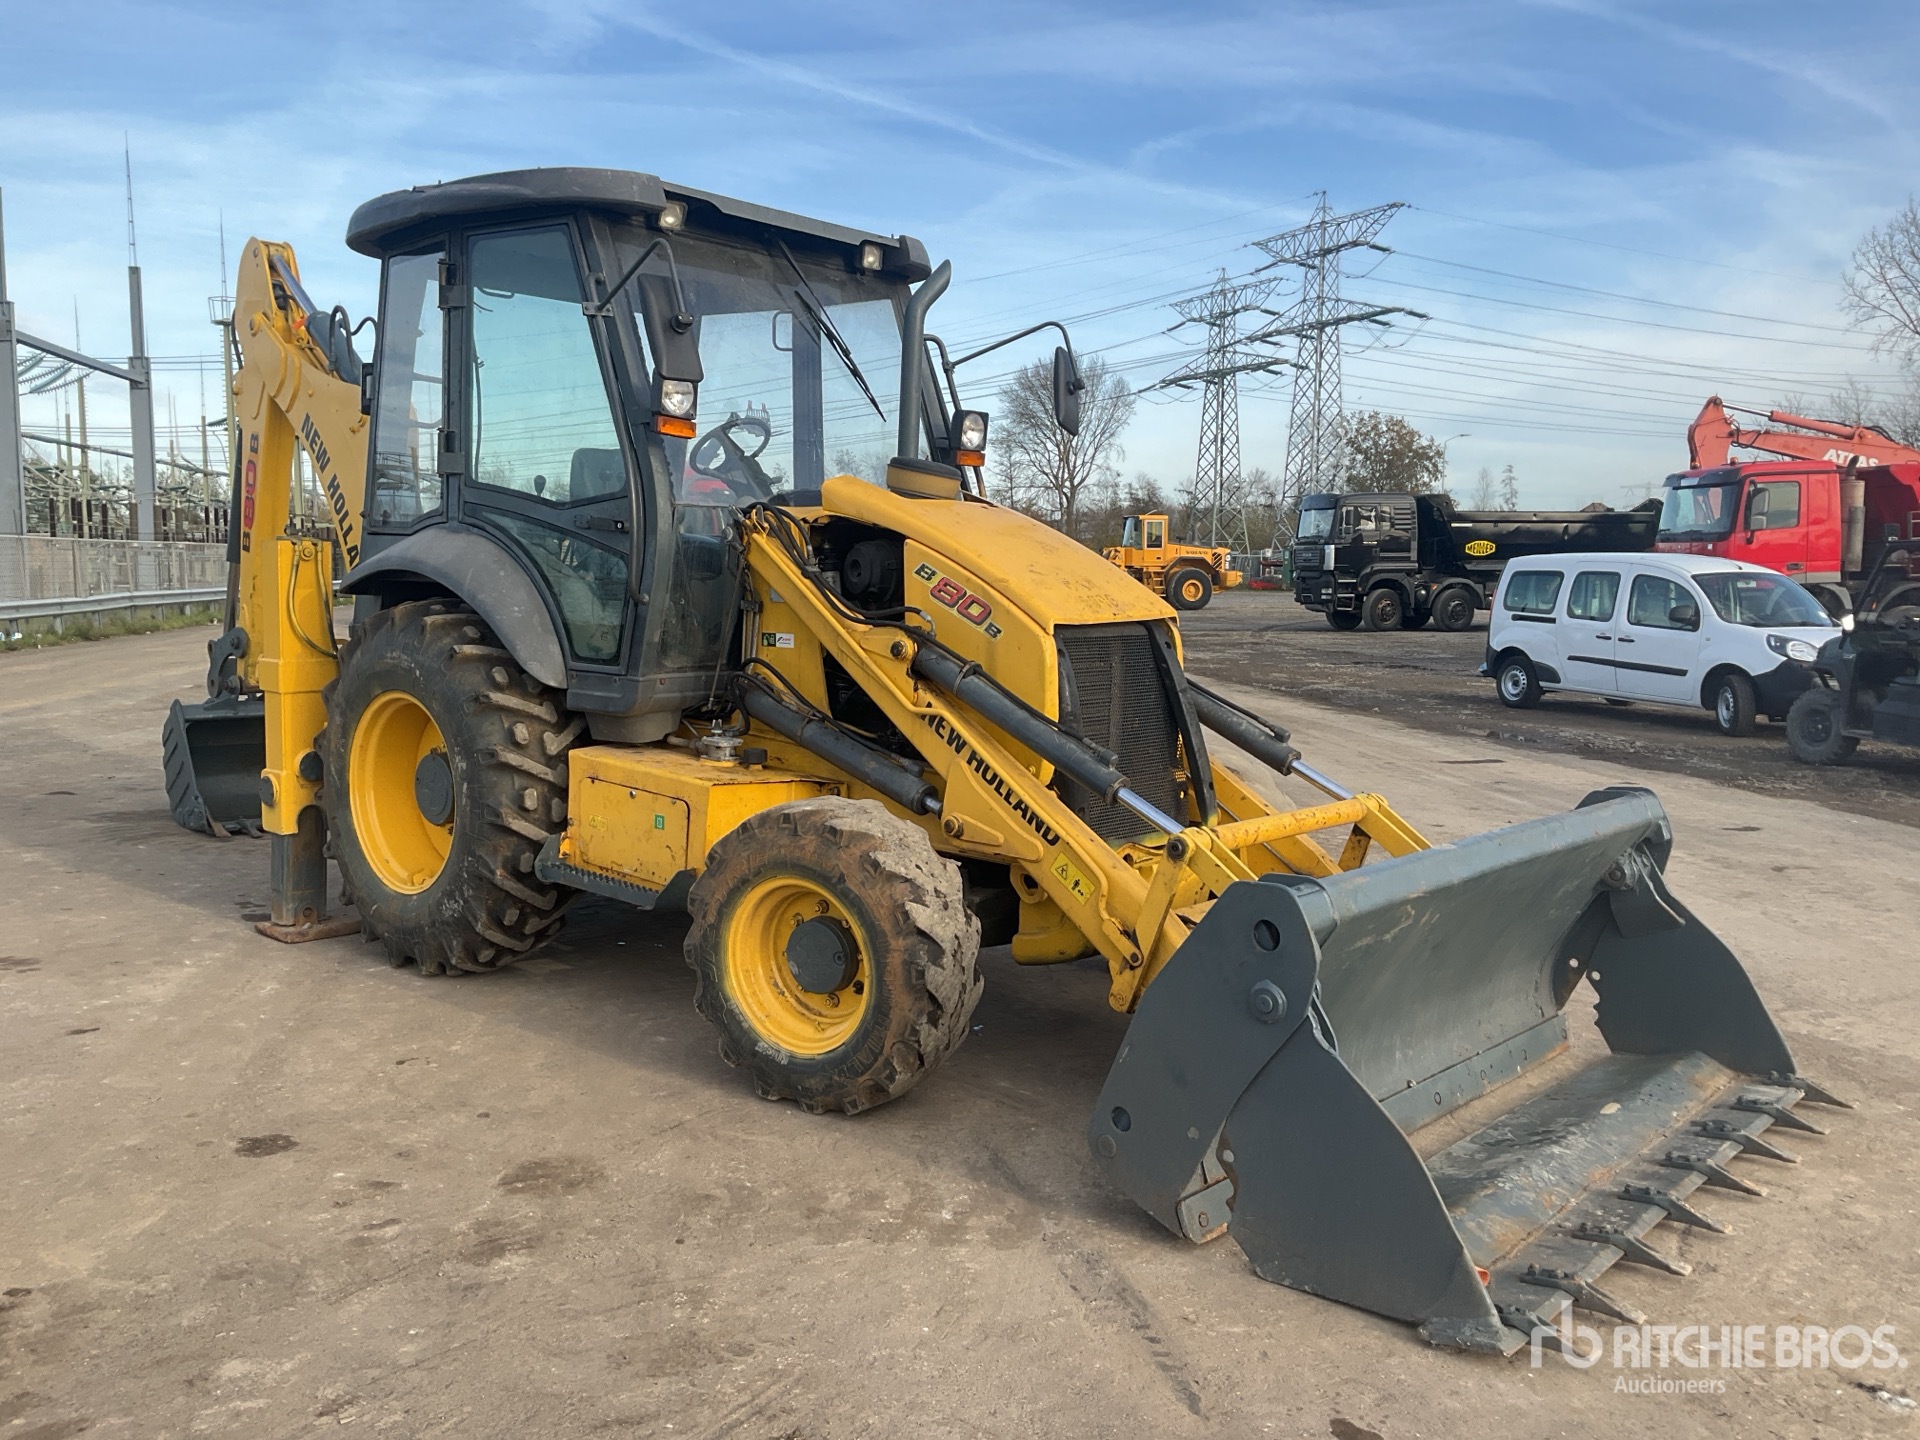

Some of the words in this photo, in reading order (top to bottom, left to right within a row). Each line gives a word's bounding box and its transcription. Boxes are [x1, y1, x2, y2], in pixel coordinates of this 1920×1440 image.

[301, 412, 331, 474] NEW
[327, 473, 360, 570] HOLLA
[1466, 542, 1494, 555] MEILLER
[920, 701, 968, 755] NEW
[966, 749, 1061, 847] HOLLAND
